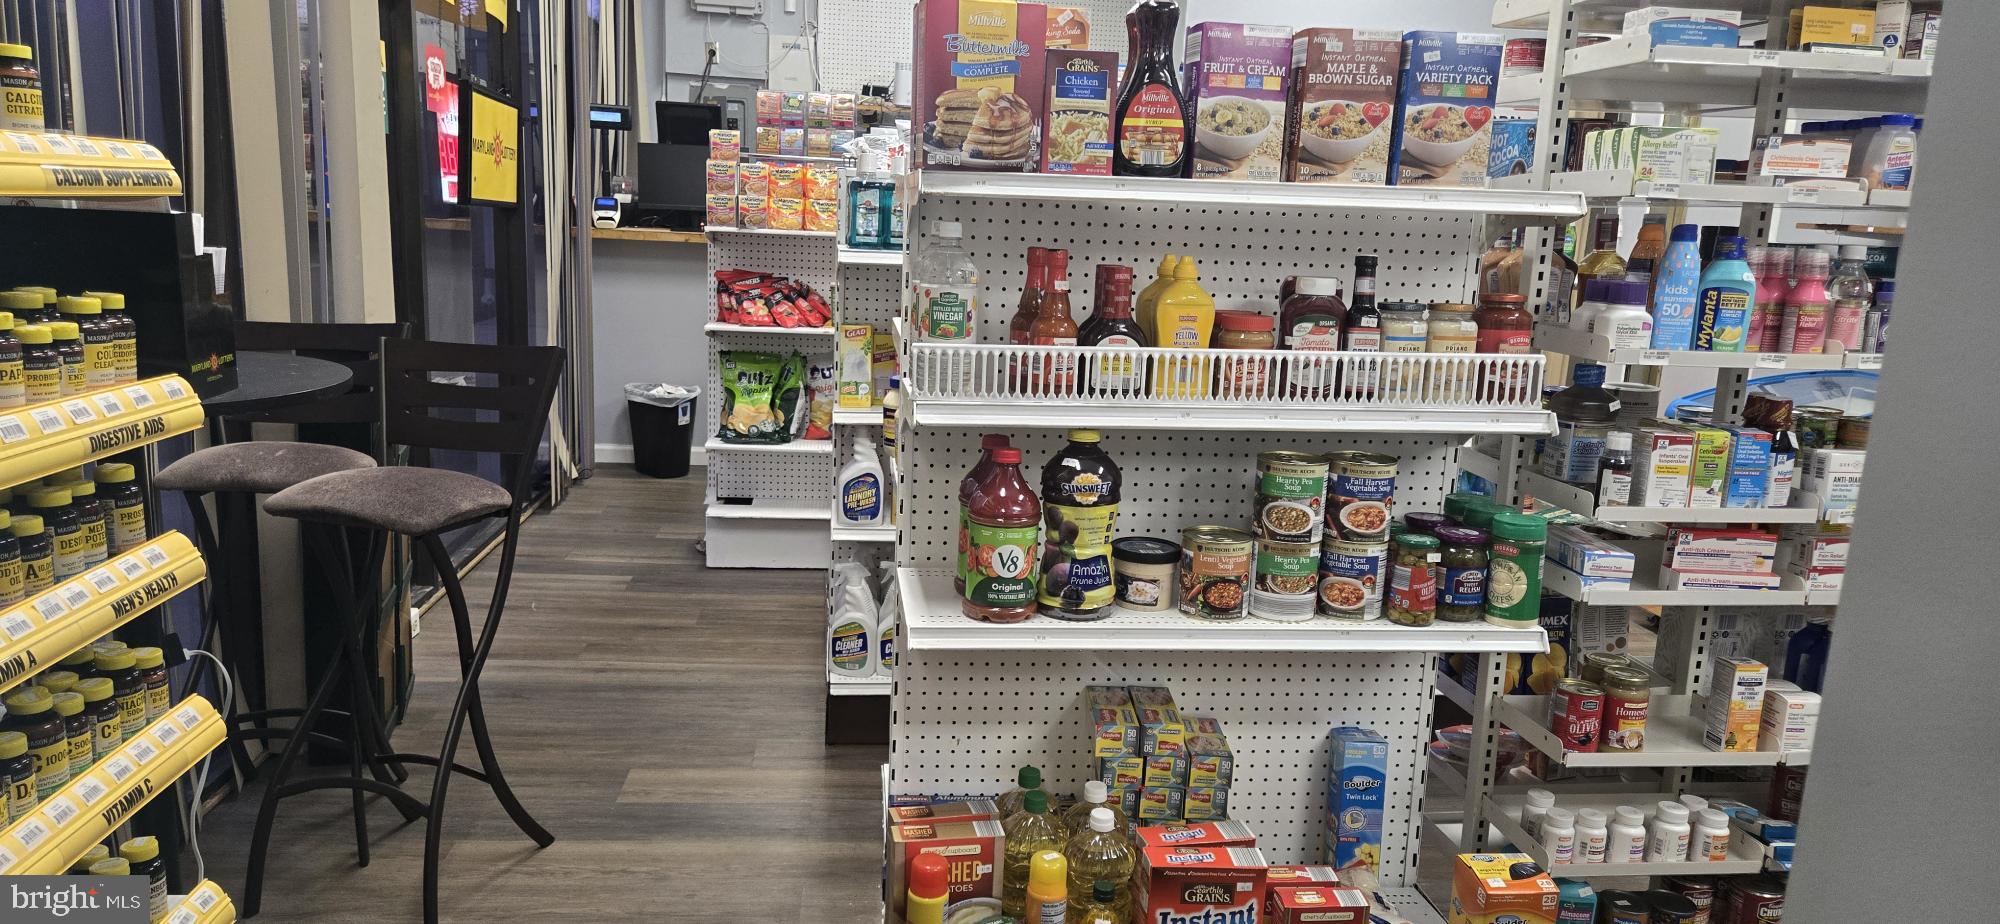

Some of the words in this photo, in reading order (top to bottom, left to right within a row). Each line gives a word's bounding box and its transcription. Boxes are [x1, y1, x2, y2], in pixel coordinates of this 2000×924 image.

[968, 15, 1007, 28] Millville
[1062, 26, 1081, 36] Soda
[943, 33, 1030, 58] Buttermilk
[1321, 52, 1352, 61] INSTANT
[1354, 54, 1387, 63] OATMEAL
[963, 65, 1009, 77] COMPLETE
[1066, 61, 1099, 73] GRAINS
[1203, 62, 1235, 73] FRUIT
[1238, 65, 1245, 73] &
[1247, 64, 1286, 77] CREAM
[1326, 63, 1367, 74] MAPLE
[1369, 64, 1378, 74] &
[1425, 63, 1455, 71] INSTANT
[1457, 64, 1488, 73] OATMEAL
[3, 77, 28, 86] MASON
[1064, 75, 1099, 87] Chicken
[1308, 73, 1353, 85] BROWN
[1356, 75, 1393, 86] SUGAR
[1415, 72, 1463, 84] VARIETY
[1465, 74, 1494, 85] PACK
[1141, 94, 1170, 103] Millville
[1133, 104, 1177, 115] Original
[1492, 134, 1509, 148] HOT
[1641, 140, 1661, 149] Allergy
[1662, 141, 1678, 149] Relief
[1489, 144, 1520, 167] COCOA
[1887, 154, 1912, 164] Antacid
[1887, 160, 1910, 169] Tablets
[1300, 166, 1310, 175] 10
[1402, 169, 1411, 177] 10
[1641, 167, 1653, 176] 24
[53, 168, 104, 187] CALCIUM
[106, 168, 174, 187] SUPPLEMENTS
[1665, 284, 1689, 295] kids
[1662, 303, 1681, 316] 50
[933, 311, 964, 321] VINEGAR
[1697, 290, 1718, 348] Mylanta
[1834, 315, 1859, 324] Citrate
[846, 328, 866, 338] GLAD
[1175, 331, 1199, 341] YELLOW
[1301, 336, 1330, 346] Tomato
[89, 424, 142, 453] DIGESTIVE
[144, 416, 165, 437] AIDS
[1275, 476, 1300, 486] Hearty
[1301, 477, 1313, 485] Pea
[1350, 477, 1364, 485] Fall
[1365, 478, 1389, 486] Harvest
[1060, 482, 1112, 495] SUNSWEET
[1284, 484, 1302, 492] Soup
[1345, 482, 1378, 491] Vegetable
[1378, 484, 1391, 492] Soup
[844, 487, 877, 504] LAUNDRY
[847, 495, 877, 509] PRE-WASH
[997, 549, 1020, 574] V8
[1199, 554, 1220, 563] Lentil
[1221, 555, 1248, 565] Vegetable
[1274, 555, 1298, 564] Hearty
[1299, 555, 1310, 563] Pea
[1325, 552, 1338, 561] Fall
[1339, 554, 1367, 564] Harvest
[1217, 562, 1234, 571] Soup
[1282, 563, 1300, 572] Soup
[1356, 561, 1370, 570] Soup
[25, 563, 38, 580] A
[1070, 577, 1094, 586] Prune
[1093, 575, 1110, 586] Juice
[991, 582, 1024, 592] Original
[111, 589, 145, 619] MEN'S
[145, 571, 178, 602] HEALTH
[835, 638, 864, 652] CLEANER
[28, 649, 38, 668] A
[1569, 719, 1600, 734] OLIVES
[1127, 729, 1137, 738] 50
[1144, 744, 1153, 753] 50
[1176, 760, 1186, 768] 50
[1221, 761, 1231, 770] 50
[1103, 777, 1112, 786] 50
[1344, 779, 1380, 789] Boulder
[1126, 793, 1135, 802] 50
[1171, 792, 1180, 801] 50
[1216, 791, 1226, 800] 50
[102, 784, 145, 827] VITAMIN
[145, 778, 153, 794] C
[901, 808, 929, 817] MASHED
[1128, 822, 1138, 832] 50
[903, 828, 933, 837] MASHED
[1161, 828, 1206, 841] Instant
[1167, 853, 1215, 863] Instant
[1540, 879, 1552, 887] 28
[1196, 884, 1224, 896] earthly
[1184, 889, 1231, 903] GRAINS
[1543, 896, 1556, 904] 28
[1158, 901, 1255, 924] Instant
